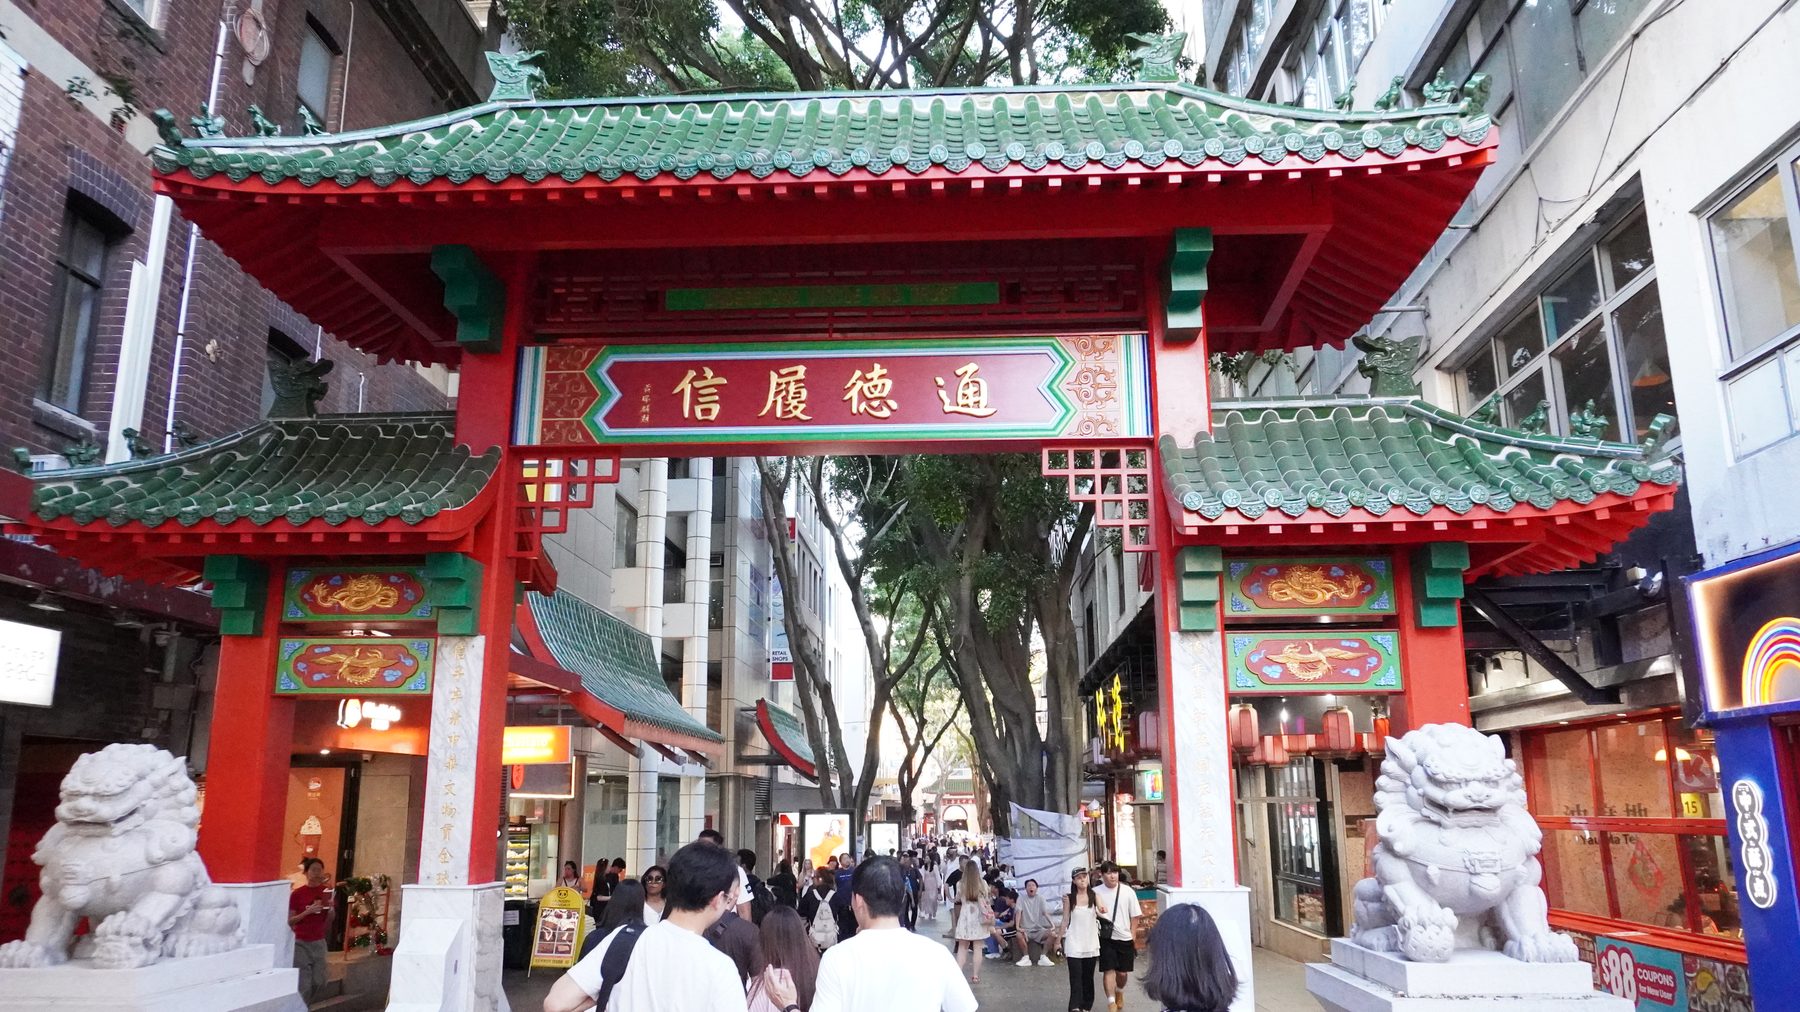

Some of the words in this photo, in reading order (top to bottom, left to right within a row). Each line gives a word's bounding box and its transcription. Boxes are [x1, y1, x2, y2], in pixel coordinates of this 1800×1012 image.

[1684, 800, 1698, 814] 15
[1601, 949, 1637, 1002] $88
[1637, 968, 1674, 987] COUPONS
[1639, 983, 1647, 993] for
[1647, 985, 1660, 997] New
[1659, 990, 1673, 1000] User
